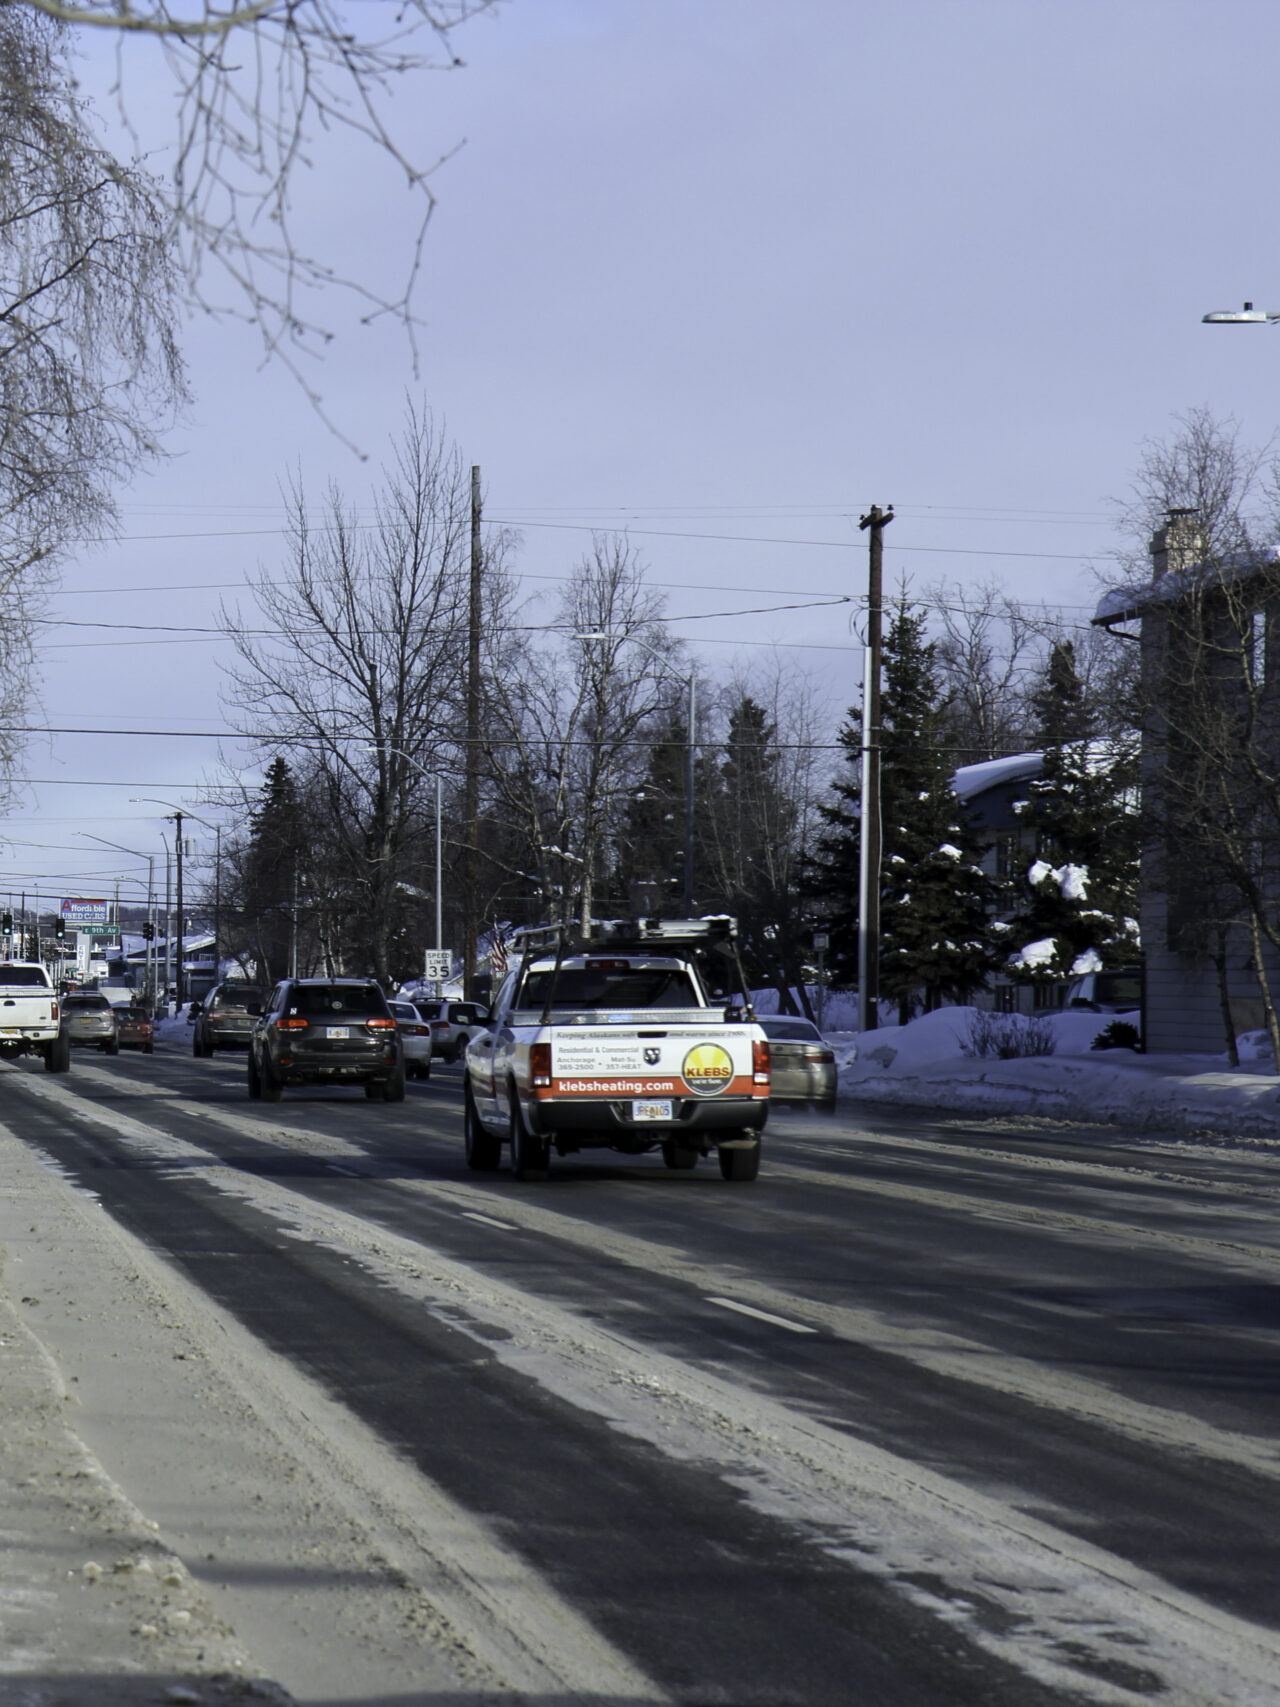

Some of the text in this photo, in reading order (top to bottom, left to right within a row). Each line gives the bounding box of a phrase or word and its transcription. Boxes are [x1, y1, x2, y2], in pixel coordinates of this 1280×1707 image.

[62, 899, 106, 912] Affordble
[62, 912, 83, 920] USED
[428, 966, 449, 978] 35
[559, 1046, 593, 1054] Residential
[686, 1067, 730, 1077] KLEBS
[559, 1081, 674, 1093] klebsheating.com
